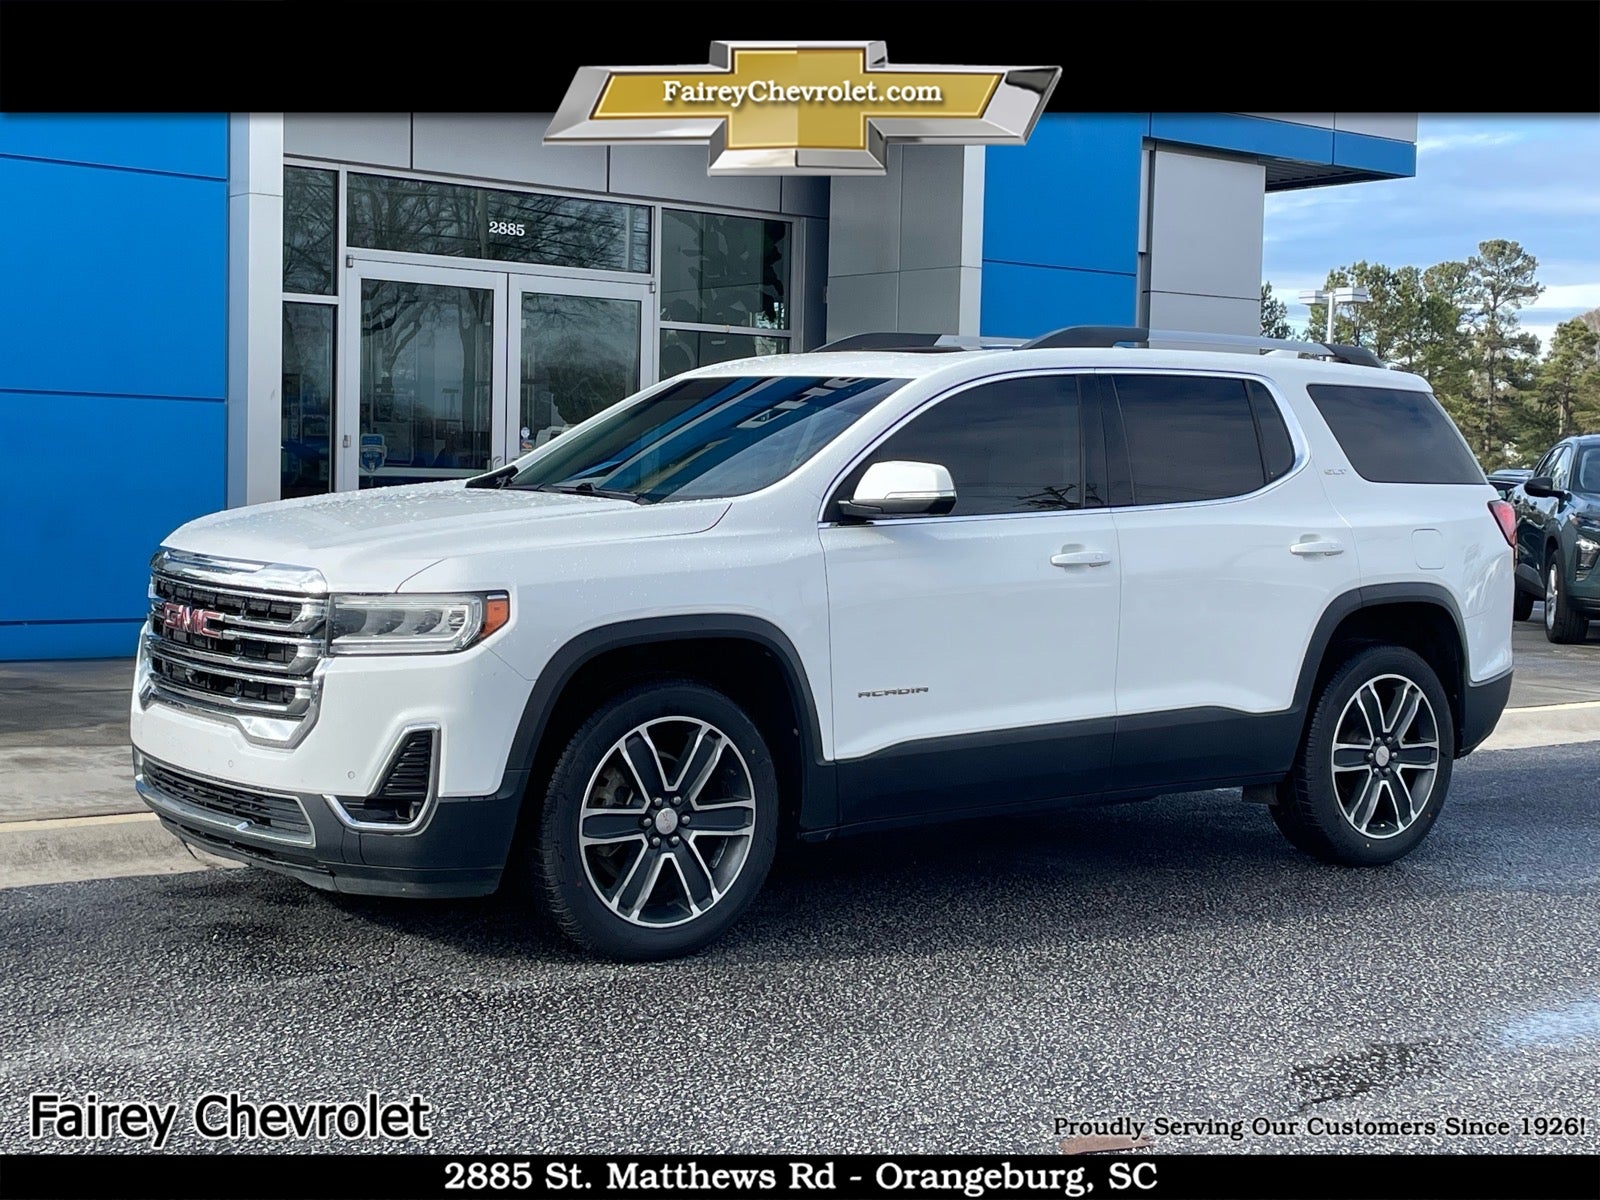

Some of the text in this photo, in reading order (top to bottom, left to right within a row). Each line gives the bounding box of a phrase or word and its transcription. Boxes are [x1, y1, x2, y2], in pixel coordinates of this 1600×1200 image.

[488, 220, 526, 237] 2885
[163, 602, 225, 640] GMC
[857, 687, 929, 698] ACADIA
